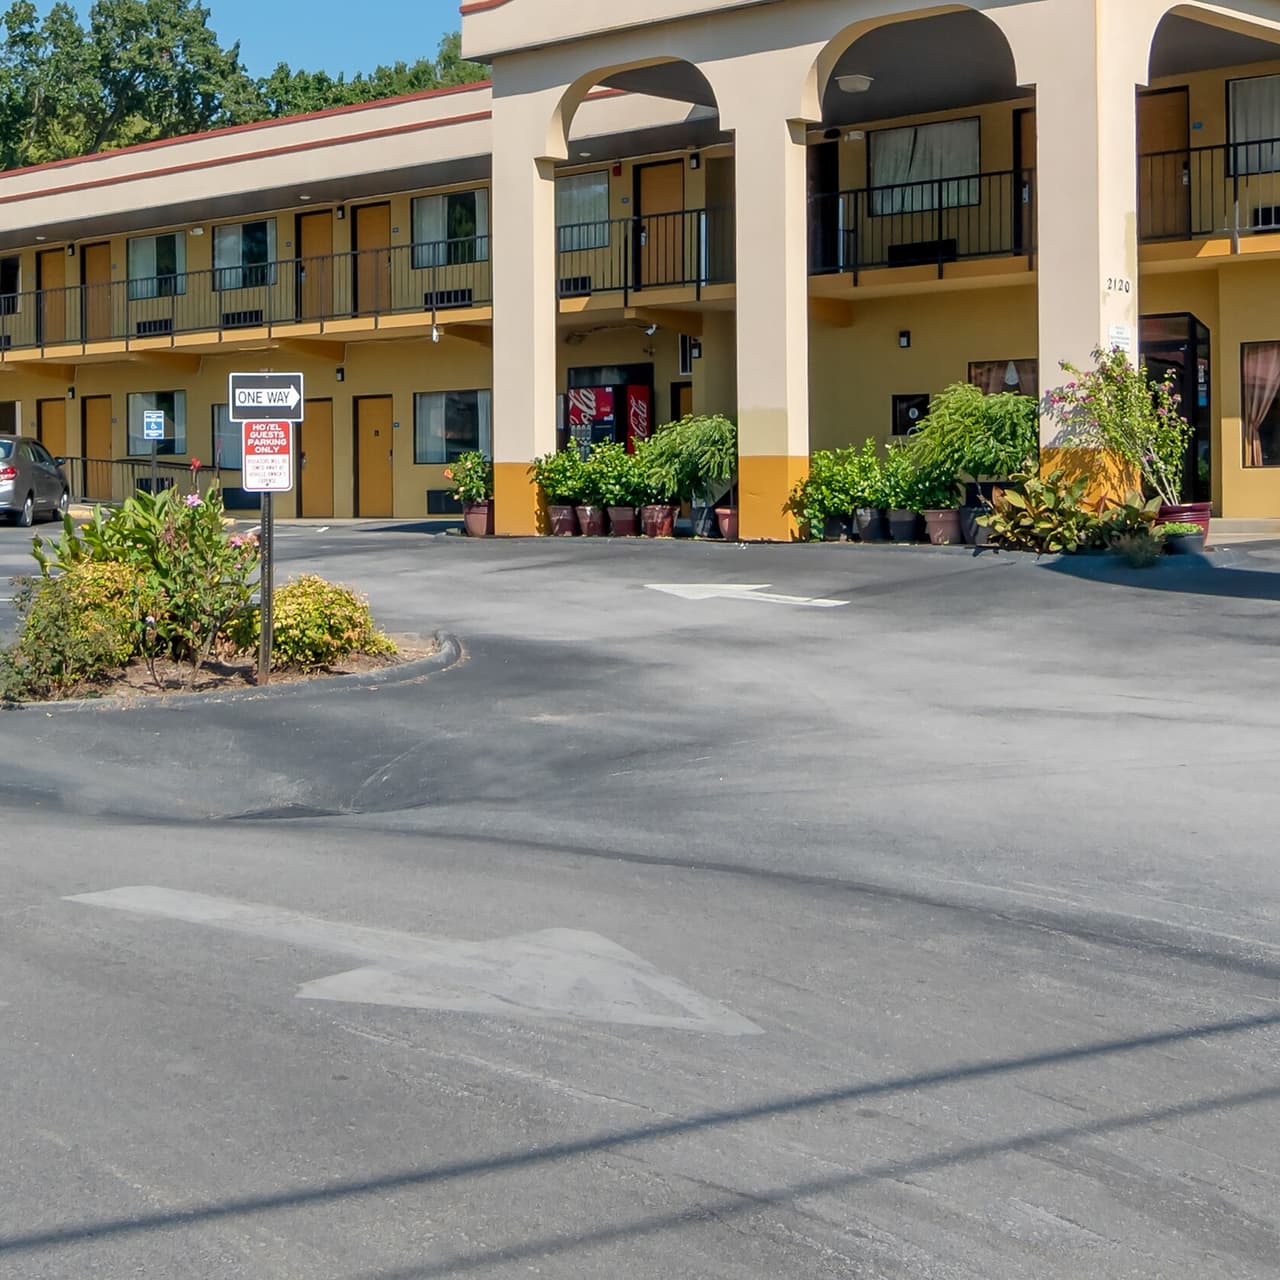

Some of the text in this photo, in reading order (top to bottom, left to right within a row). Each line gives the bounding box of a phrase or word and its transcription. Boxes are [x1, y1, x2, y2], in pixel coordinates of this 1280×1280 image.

[1106, 277, 1130, 293] 2120
[238, 391, 290, 404] ONE WAY
[252, 423, 282, 431] HOTEL
[247, 438, 287, 446] PARKING
